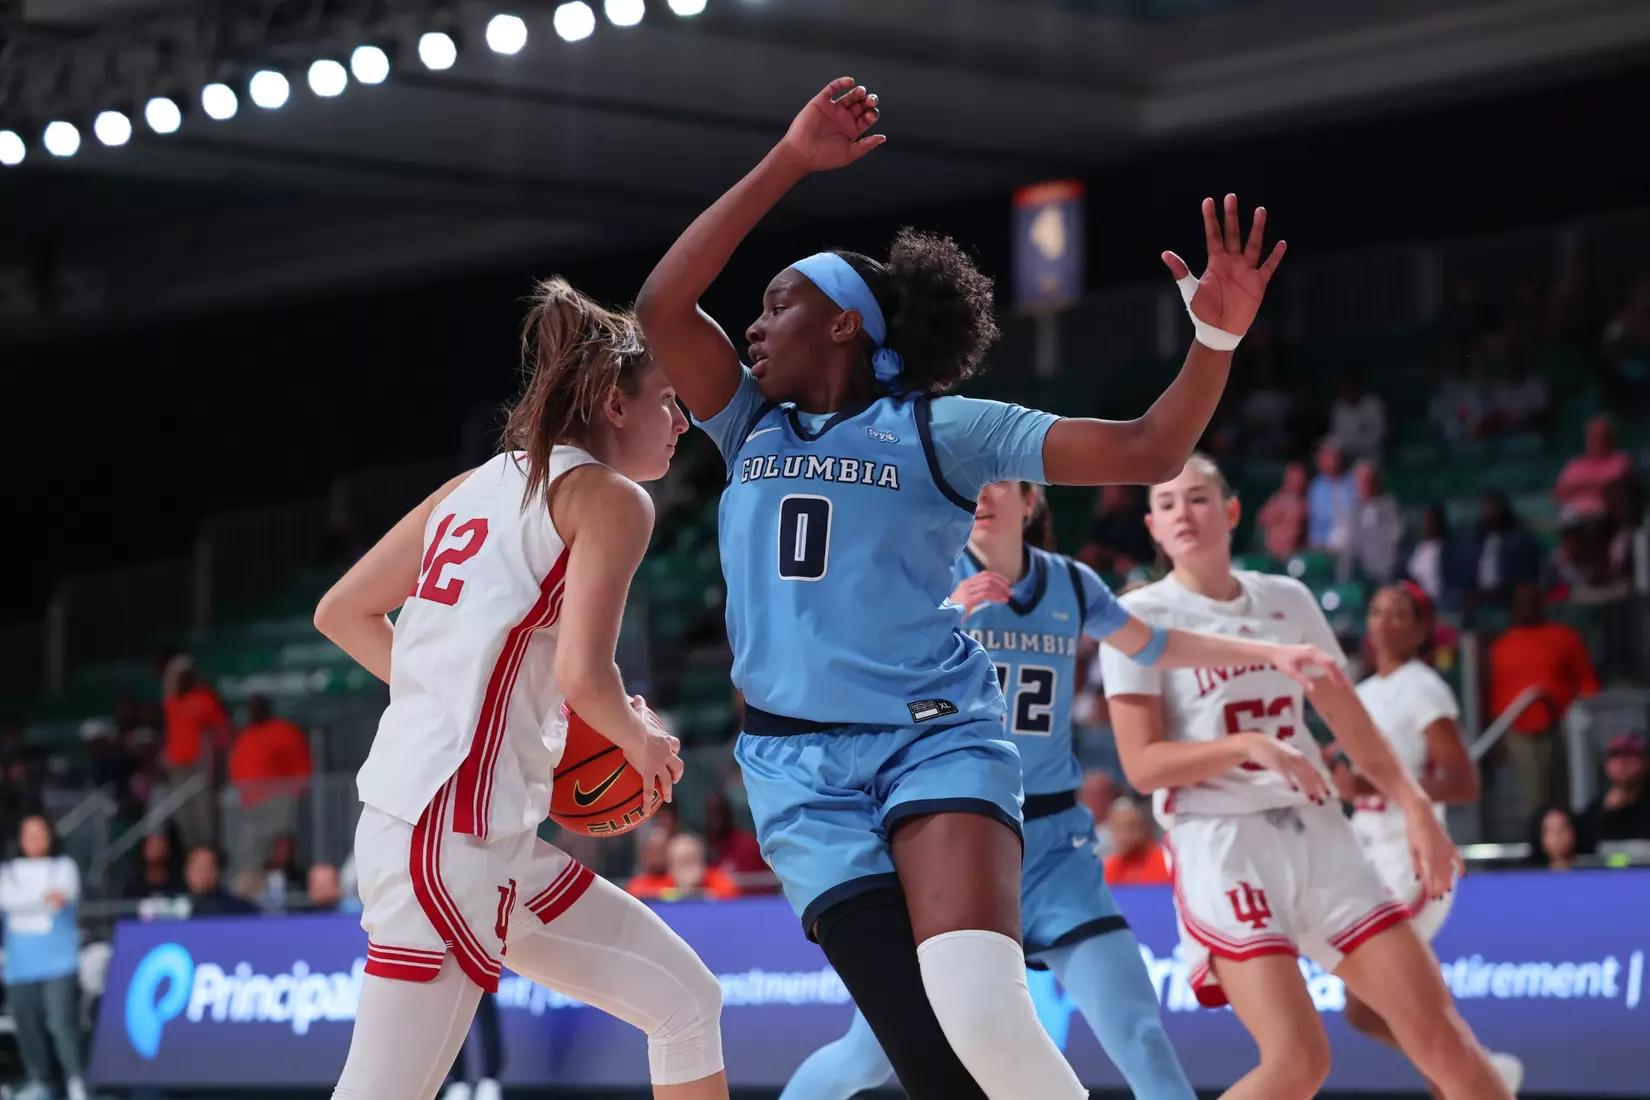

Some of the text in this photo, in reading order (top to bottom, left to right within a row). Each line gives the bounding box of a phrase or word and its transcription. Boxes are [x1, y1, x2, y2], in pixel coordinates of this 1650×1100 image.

[741, 454, 900, 490] COLUMBIA
[408, 513, 489, 607] 12
[778, 493, 832, 582] 0
[968, 629, 1077, 657] OLUMBIA
[1440, 954, 1619, 999] etirement
